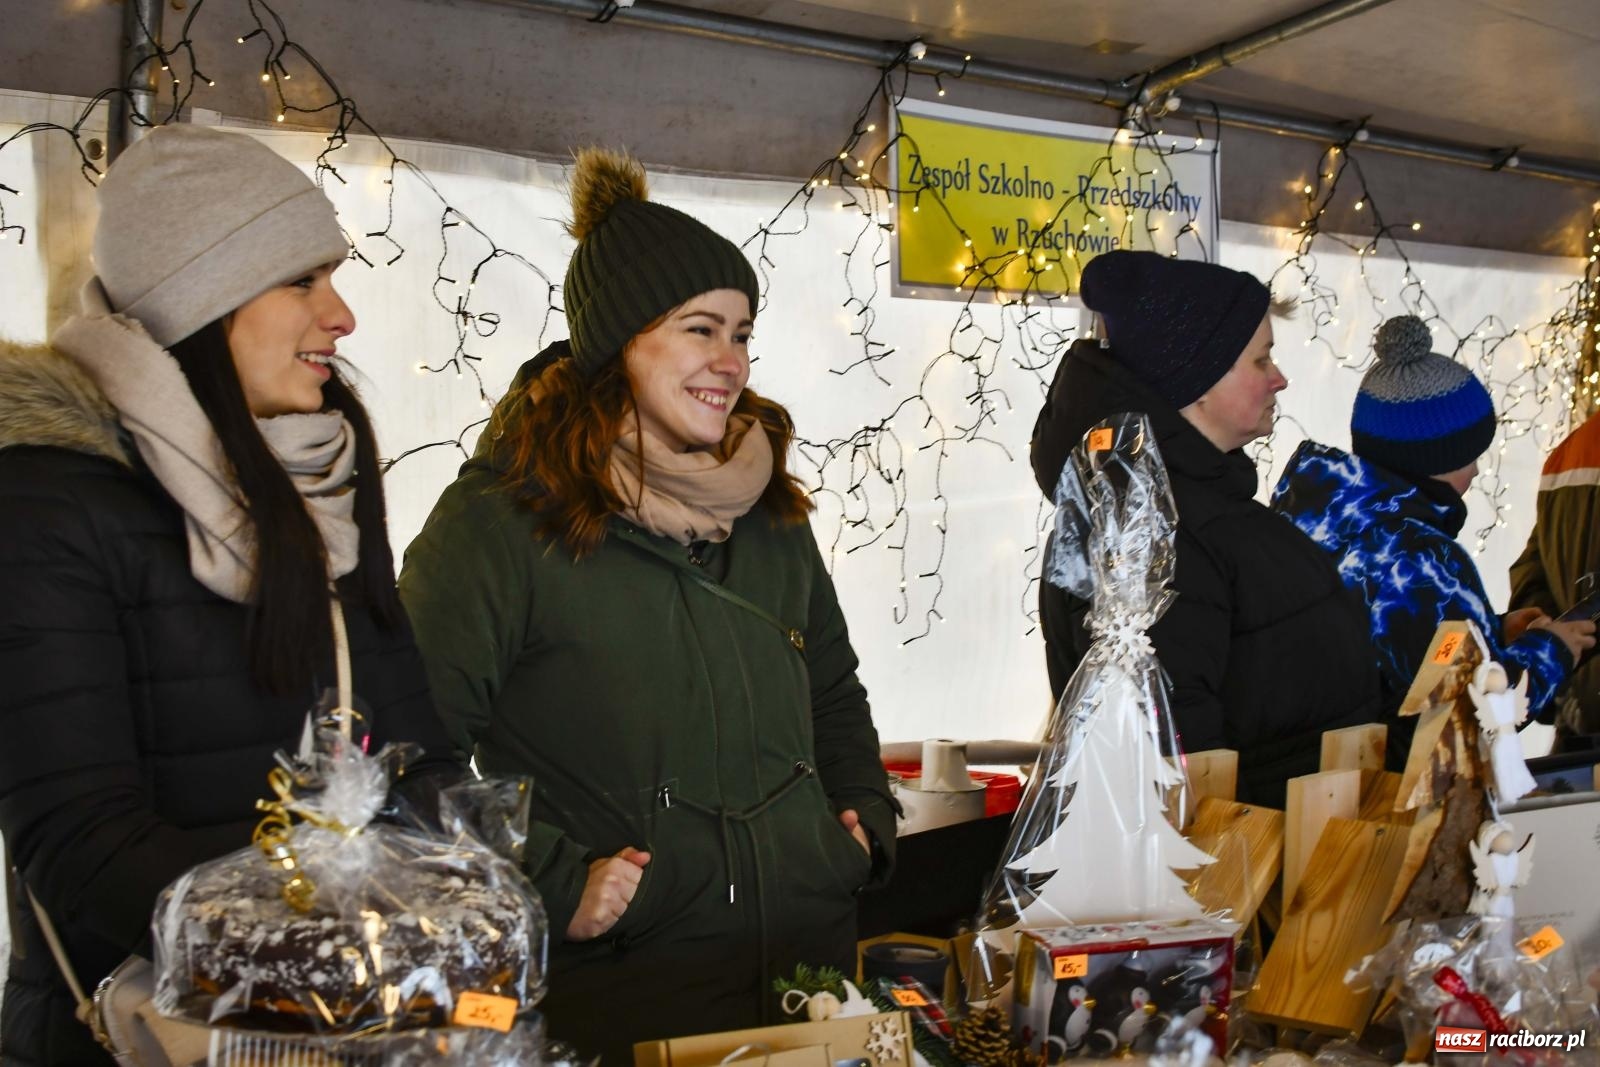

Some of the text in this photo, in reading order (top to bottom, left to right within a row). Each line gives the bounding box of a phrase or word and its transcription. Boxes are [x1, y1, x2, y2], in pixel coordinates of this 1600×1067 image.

[908, 154, 971, 199] Zespół
[979, 162, 1055, 201] Szkolno
[1078, 174, 1202, 222] Przedszkolny
[992, 218, 1120, 253] w Rzuchowie
